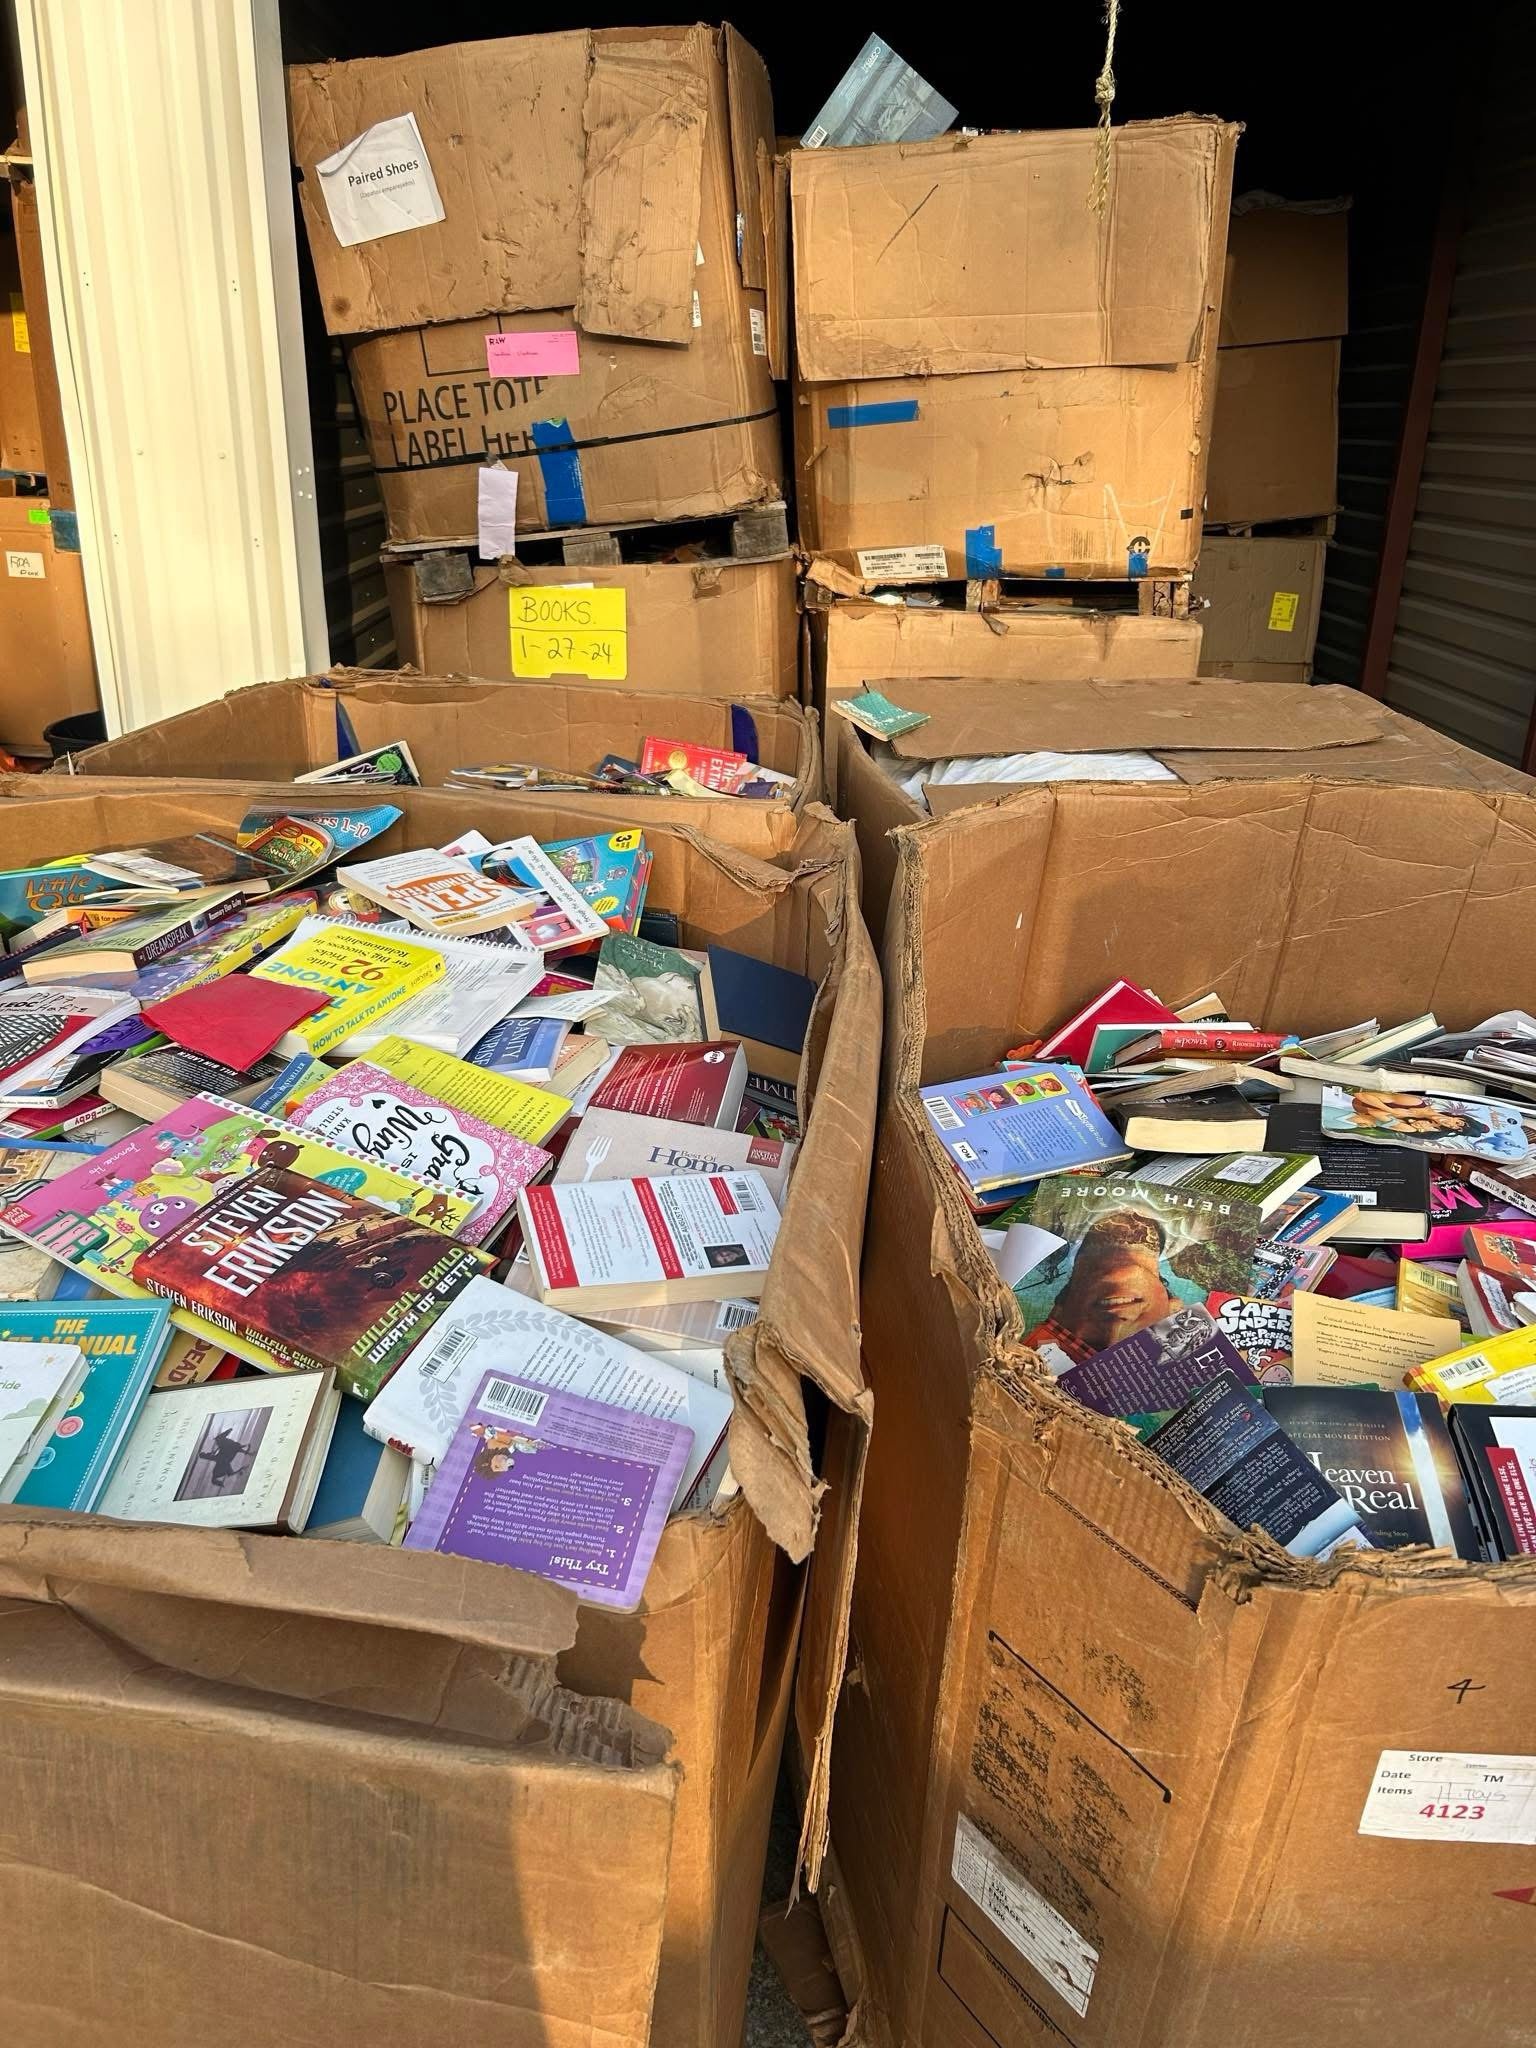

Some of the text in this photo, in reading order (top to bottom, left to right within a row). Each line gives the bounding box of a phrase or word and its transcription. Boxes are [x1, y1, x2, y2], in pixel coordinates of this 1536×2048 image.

[348, 160, 418, 187] Paired Shoes
[383, 384, 471, 425] PLACE
[391, 427, 467, 466] LABEL
[25, 873, 93, 899] Little
[145, 924, 190, 961] DREAMSPEAK
[336, 933, 409, 958] Relationships
[312, 937, 411, 970] for Big Success in
[316, 947, 346, 961] Tricks
[306, 956, 390, 981] 92 Little
[264, 961, 377, 995] ANYONE
[312, 984, 407, 1051] HOW TO TALK TO ANYONE
[472, 1019, 514, 1065] SUNRISE
[502, 1017, 541, 1059] SANITY
[1182, 1036, 1208, 1047] POWER
[956, 1141, 974, 1159] TOM
[401, 1154, 418, 1169] IS
[647, 1145, 735, 1174] Home
[1475, 1176, 1500, 1193] KINNEY
[1061, 1186, 1232, 1215] BETH MOORE
[182, 1184, 288, 1257] STEVEN
[675, 1211, 688, 1233] AUGUST
[203, 1189, 353, 1298] ERIKSON
[146, 1277, 238, 1335] STEVEN ERIKSON
[351, 1247, 467, 1359] WILLFUL CHILD
[367, 1253, 478, 1365] WRATH OF BETTY
[1219, 1297, 1293, 1320] CAPT
[54, 1318, 90, 1335] THE
[1215, 1317, 1293, 1334] UNDER
[1257, 1328, 1293, 1341] PERILO
[245, 1327, 324, 1369] WILLFUL CHILD
[245, 1335, 292, 1364] WRATH OF
[1233, 1338, 1272, 1349] FESSOR
[1324, 1433, 1351, 1441] MOVIE
[1351, 1433, 1391, 1441] EDITION
[1498, 1465, 1508, 1481] ELSE.
[1506, 1460, 1517, 1475] ELSE.
[1503, 1484, 1512, 1495] ONE
[1512, 1477, 1521, 1489] ONE
[620, 1496, 631, 1506] 3.
[1341, 1481, 1420, 1514] Real
[1507, 1497, 1516, 1505] NO
[1516, 1491, 1525, 1499] NO
[1511, 1508, 1521, 1521] LIKE
[1519, 1502, 1531, 1515] LIKE
[612, 1524, 624, 1534] 2.
[1516, 1523, 1525, 1536] LIVE
[1524, 1516, 1534, 1533] LIVE
[605, 1548, 615, 1558] 1.
[549, 1554, 609, 1575] Try This!
[1446, 1678, 1486, 1705] 4
[1408, 1753, 1443, 1763] Store
[1381, 1770, 1505, 1783] Date TM
[1377, 1787, 1413, 1796] Items
[1418, 1804, 1486, 1820] 4123
